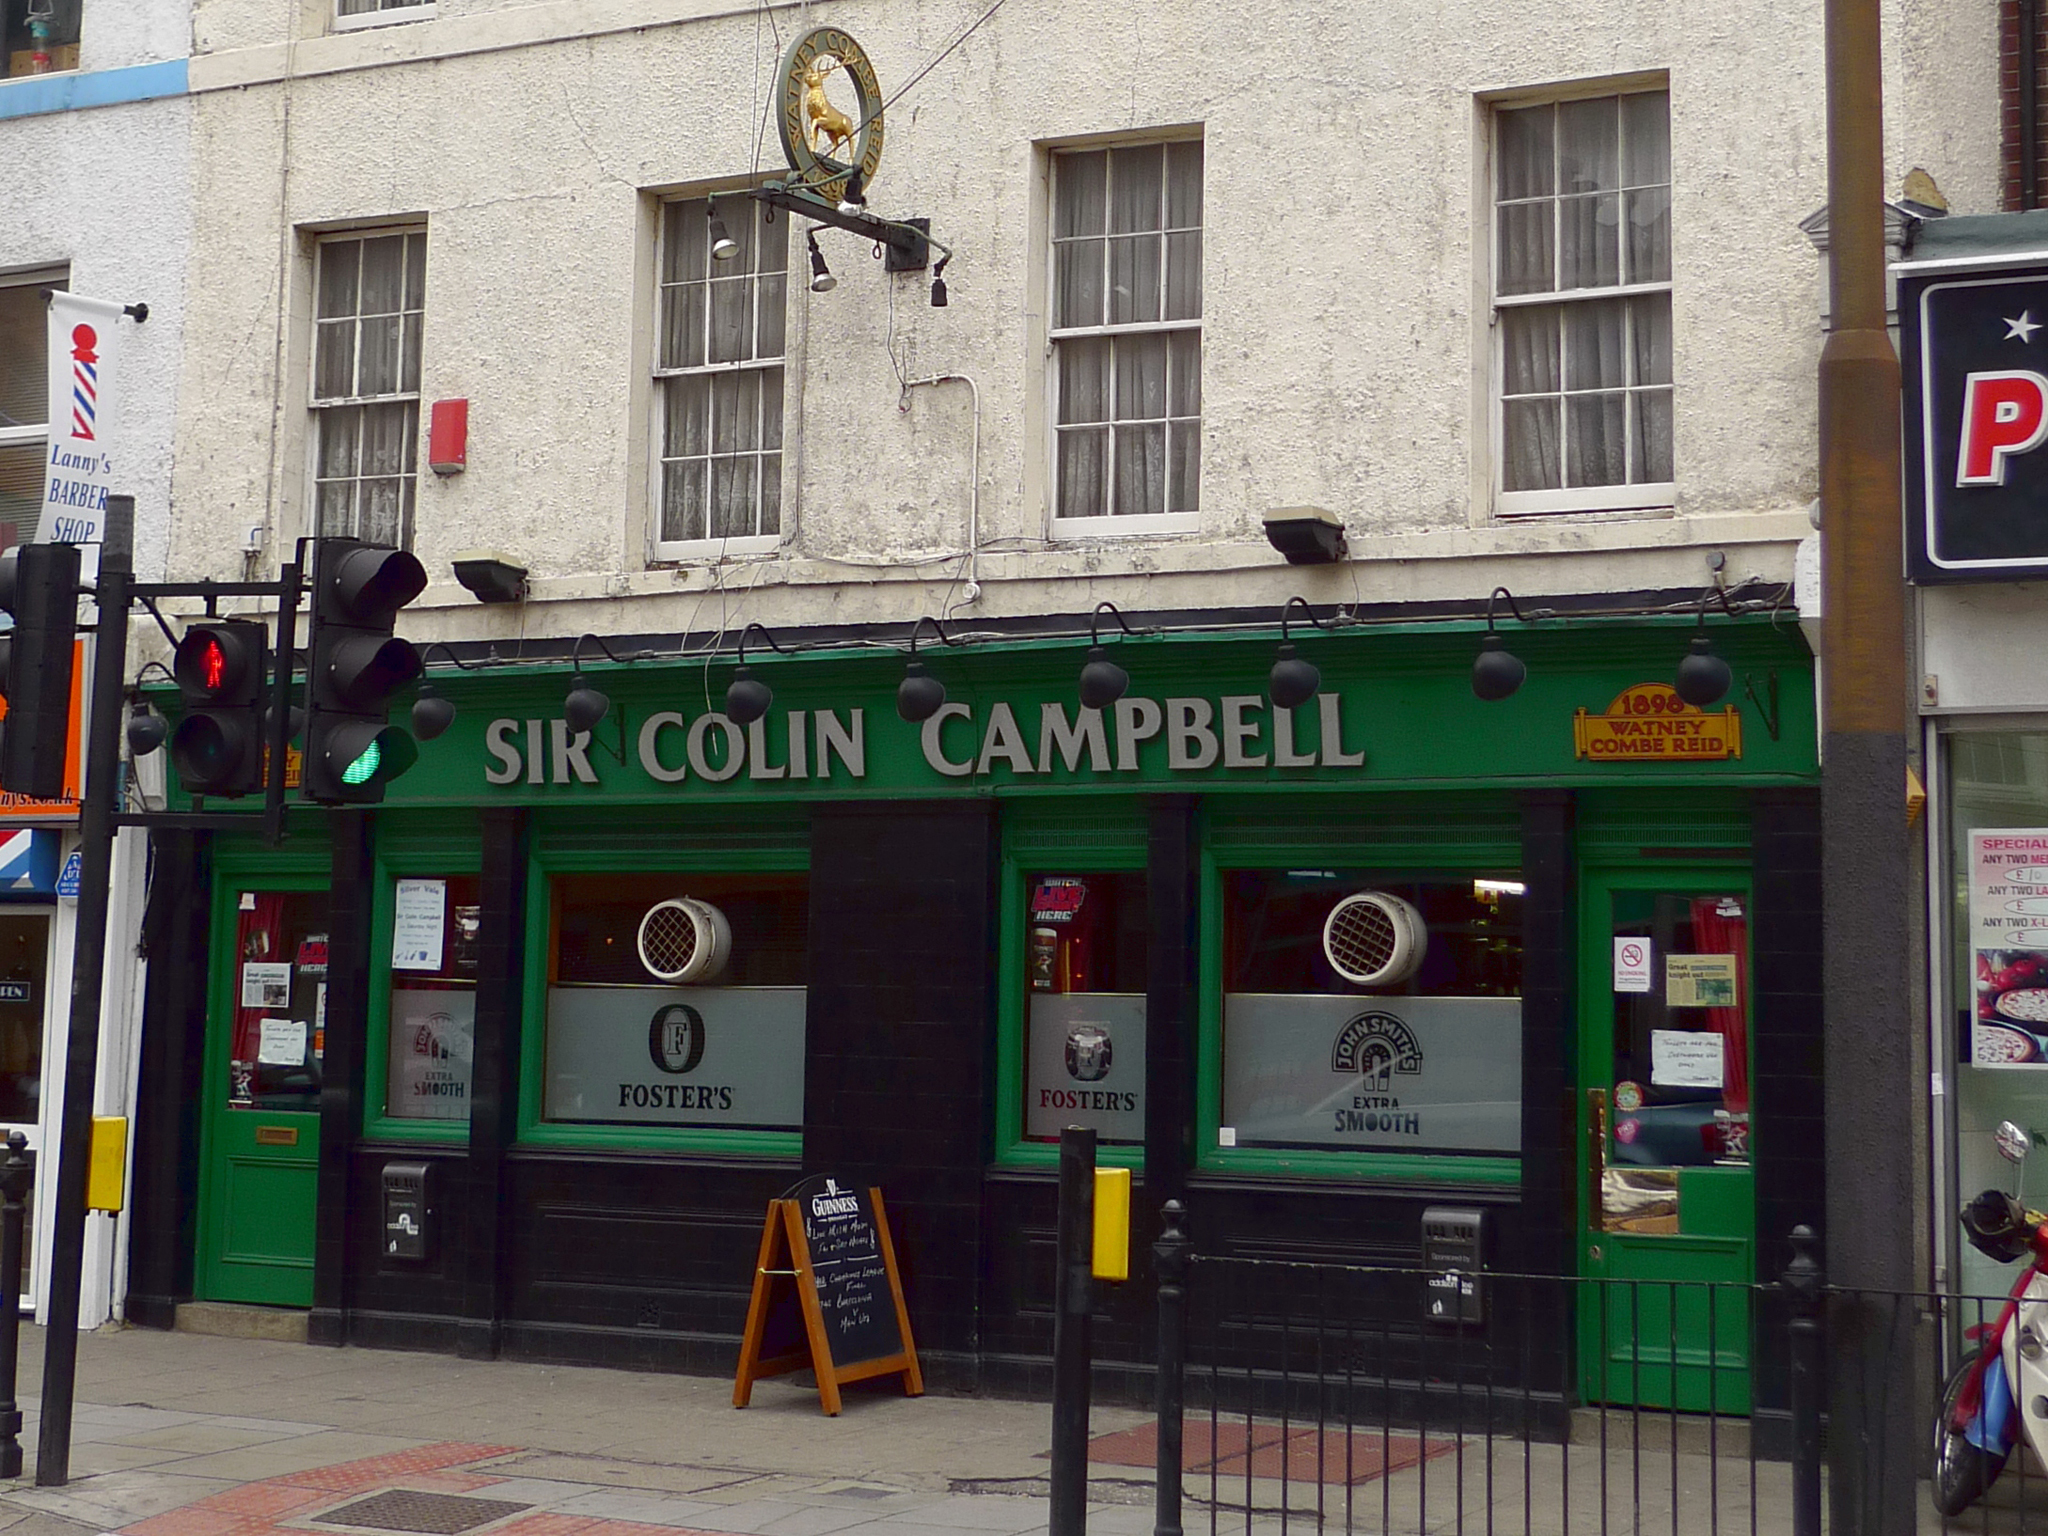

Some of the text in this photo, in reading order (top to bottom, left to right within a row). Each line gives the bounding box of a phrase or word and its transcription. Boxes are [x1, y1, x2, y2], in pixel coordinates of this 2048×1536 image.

[787, 33, 818, 151] WATNEY
[862, 118, 881, 177] REID
[50, 444, 111, 476] Lanny's
[49, 478, 109, 510] BARBER
[50, 516, 95, 543] SHOP
[1608, 720, 1706, 736] WATNEY
[485, 693, 1365, 785] SIR COLIN CAMPBELL
[1590, 737, 1723, 753] COMBE REID
[1982, 854, 2002, 864] ANY
[2005, 854, 2028, 864] TWO
[1987, 885, 2008, 896] ANY
[2010, 885, 2033, 895] TWO
[1036, 910, 1072, 920] HERE
[1982, 917, 2002, 927] ANY
[2005, 917, 2028, 927] TWO
[0, 986, 23, 997] PEN
[1337, 1020, 1368, 1067] JOHN
[1370, 1018, 1422, 1069] SMITH'S
[425, 1071, 453, 1081] EXTRA
[414, 1082, 464, 1098] SMOOTH
[619, 1084, 732, 1111] FOSTER'S
[1040, 1088, 1136, 1112] FOSTER'S
[1353, 1096, 1400, 1110] EXTRA
[1334, 1109, 1420, 1135] SMOOTH
[812, 1196, 859, 1217] GUINNESS
